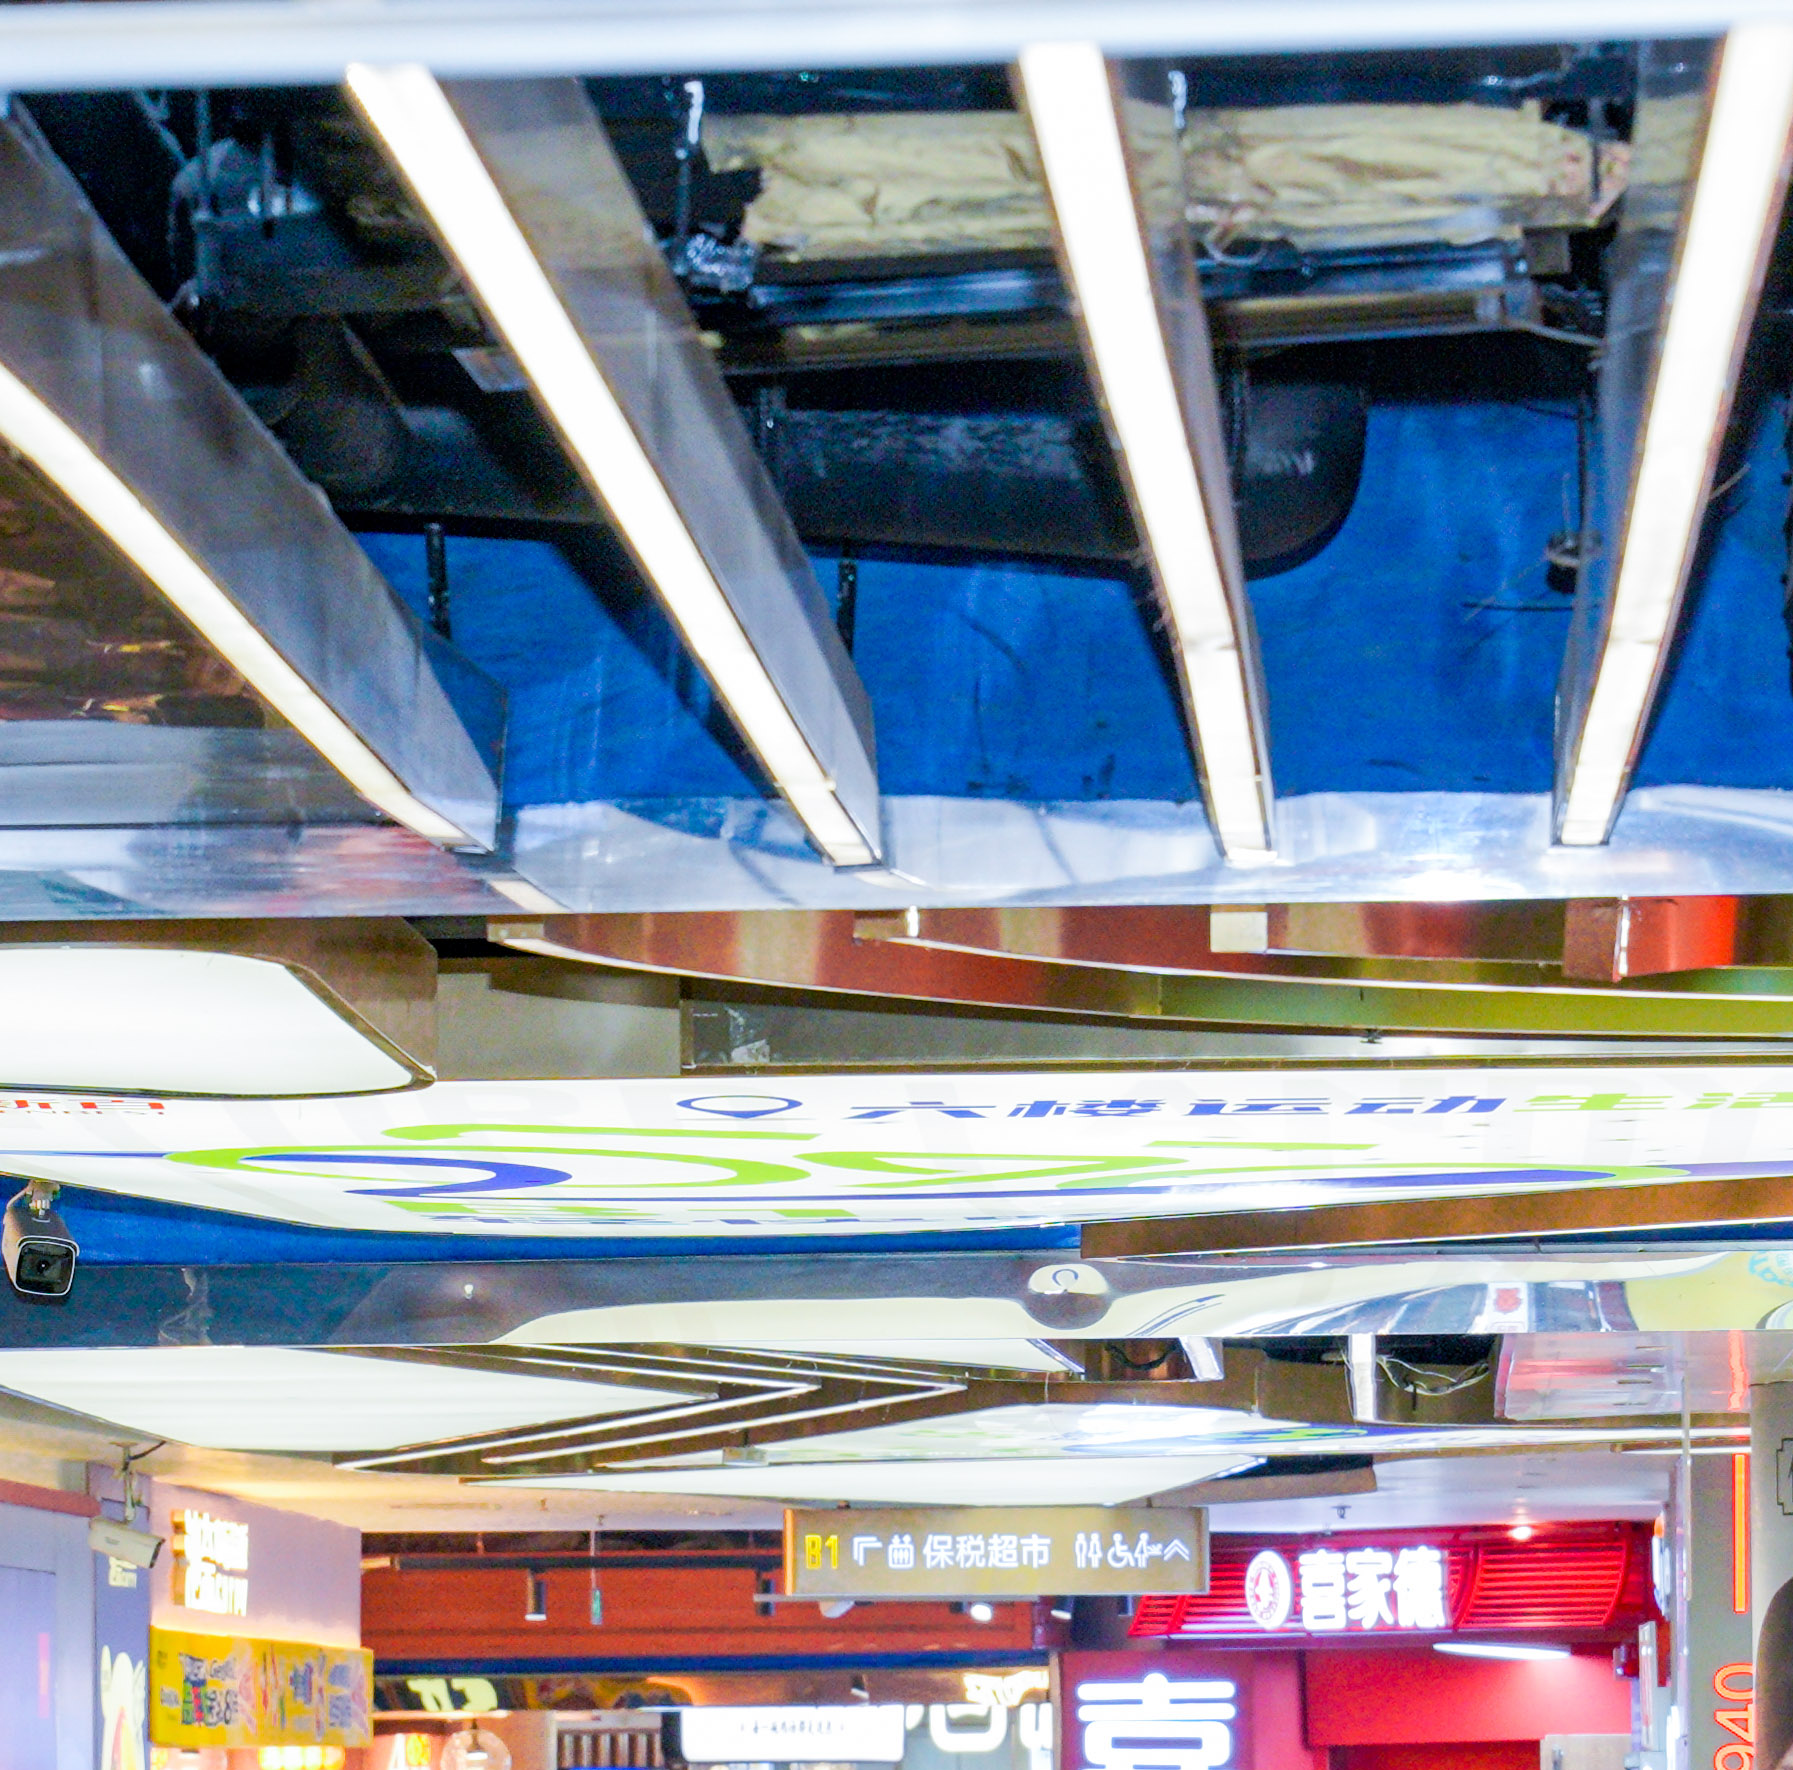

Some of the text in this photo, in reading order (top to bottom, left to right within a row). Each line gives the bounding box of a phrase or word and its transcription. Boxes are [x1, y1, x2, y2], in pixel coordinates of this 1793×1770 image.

[805, 1533, 1052, 1570] B1 保税超市
